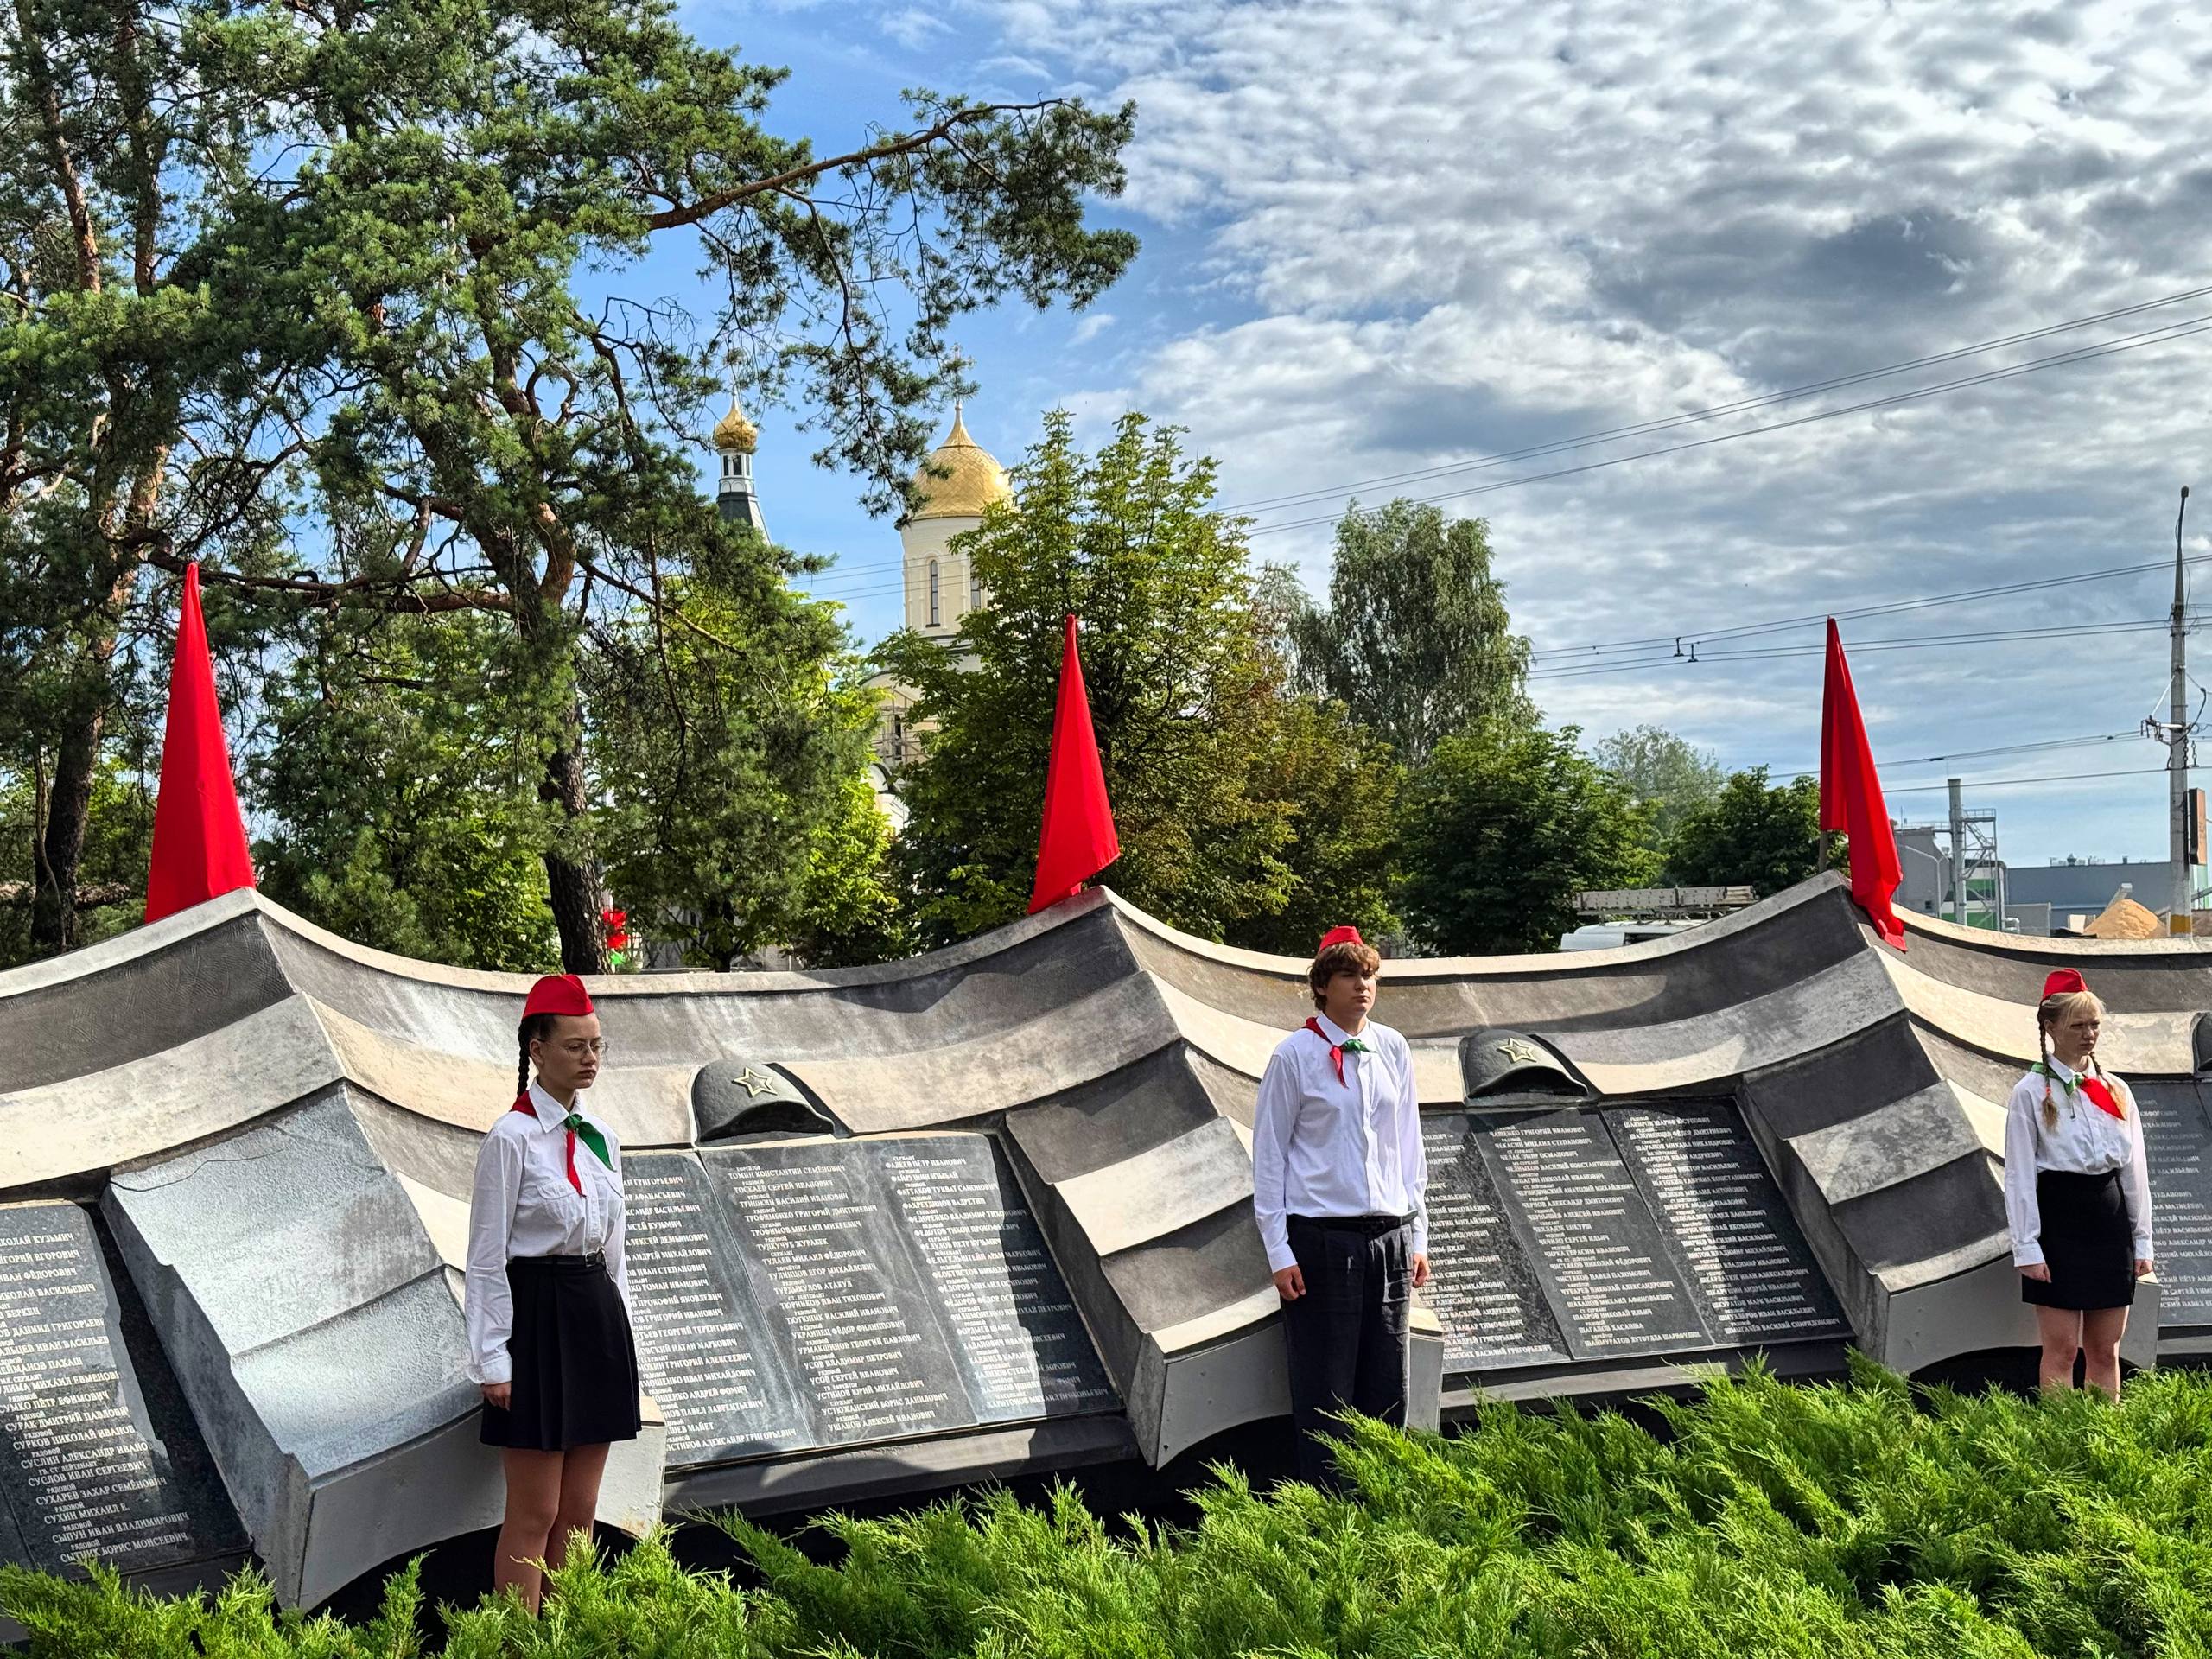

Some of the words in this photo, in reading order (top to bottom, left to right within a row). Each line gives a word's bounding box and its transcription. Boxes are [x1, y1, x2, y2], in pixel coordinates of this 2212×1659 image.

[32, 1232, 74, 1243] КУЗЬМИЧ
[625, 1235, 658, 1246] АЛЕКСЕЙ
[34, 1249, 80, 1261] ЕГОРОВИЧ
[632, 1250, 661, 1261] АНДРЕЙ
[23, 1267, 77, 1280] ФЁДОРОВИЧ
[636, 1267, 658, 1276] ИВАН
[658, 1263, 707, 1274] СТЕПАНОВИЧ
[36, 1283, 95, 1296] ВАСИЛЬЕВИЧ
[641, 1281, 669, 1291] РОМАН
[669, 1278, 709, 1288] ИВАНОВИЧ
[683, 1307, 723, 1319] ИВАНОВИЧ
[35, 1340, 62, 1351] ИВАН
[882, 1334, 921, 1344] ПАВЛОВИЧ
[803, 1360, 824, 1370] УСОВ
[865, 1351, 903, 1362] ПЕТРОВИЧ
[30, 1376, 72, 1389] МИХАИЛ
[683, 1374, 704, 1382] ИВАН
[809, 1376, 830, 1385] УСОВ
[830, 1370, 859, 1382] СЕРГЕЙ
[858, 1367, 899, 1378] ИВАНОВИЧ
[850, 1384, 874, 1395] ЮРИЙ
[32, 1397, 55, 1408] ПЁТР
[57, 1391, 109, 1405] ЕФИМОВИЧ
[38, 1412, 83, 1427] ДМИТРИЙ
[895, 1410, 935, 1422] ИВАНОВИЧ
[12, 1437, 50, 1450] СУРКОВ
[51, 1428, 97, 1444] НИКОЛАЙ
[20, 1455, 60, 1469] СУСЛИН
[62, 1446, 115, 1462] АЛЕКСАНДР
[28, 1472, 67, 1486] СУСЛОВ
[67, 1468, 94, 1480] ИВАН
[95, 1460, 146, 1475] СЕРГЕЕВИЧ
[35, 1491, 79, 1505] СУХАРЕВ
[79, 1485, 110, 1497] ЗАХАР
[111, 1477, 166, 1492] СЕМЁНОВИЧ
[43, 1510, 78, 1524] СУХИН
[78, 1503, 119, 1518] МИХАИЛ
[51, 1529, 86, 1543] СЫПУН
[87, 1524, 114, 1537] ИВАН
[115, 1512, 188, 1532] ВЛАДИМИРОВИЧ
[100, 1541, 131, 1555] БОРИС
[131, 1532, 188, 1549] МОИСЕЕВИЧ
